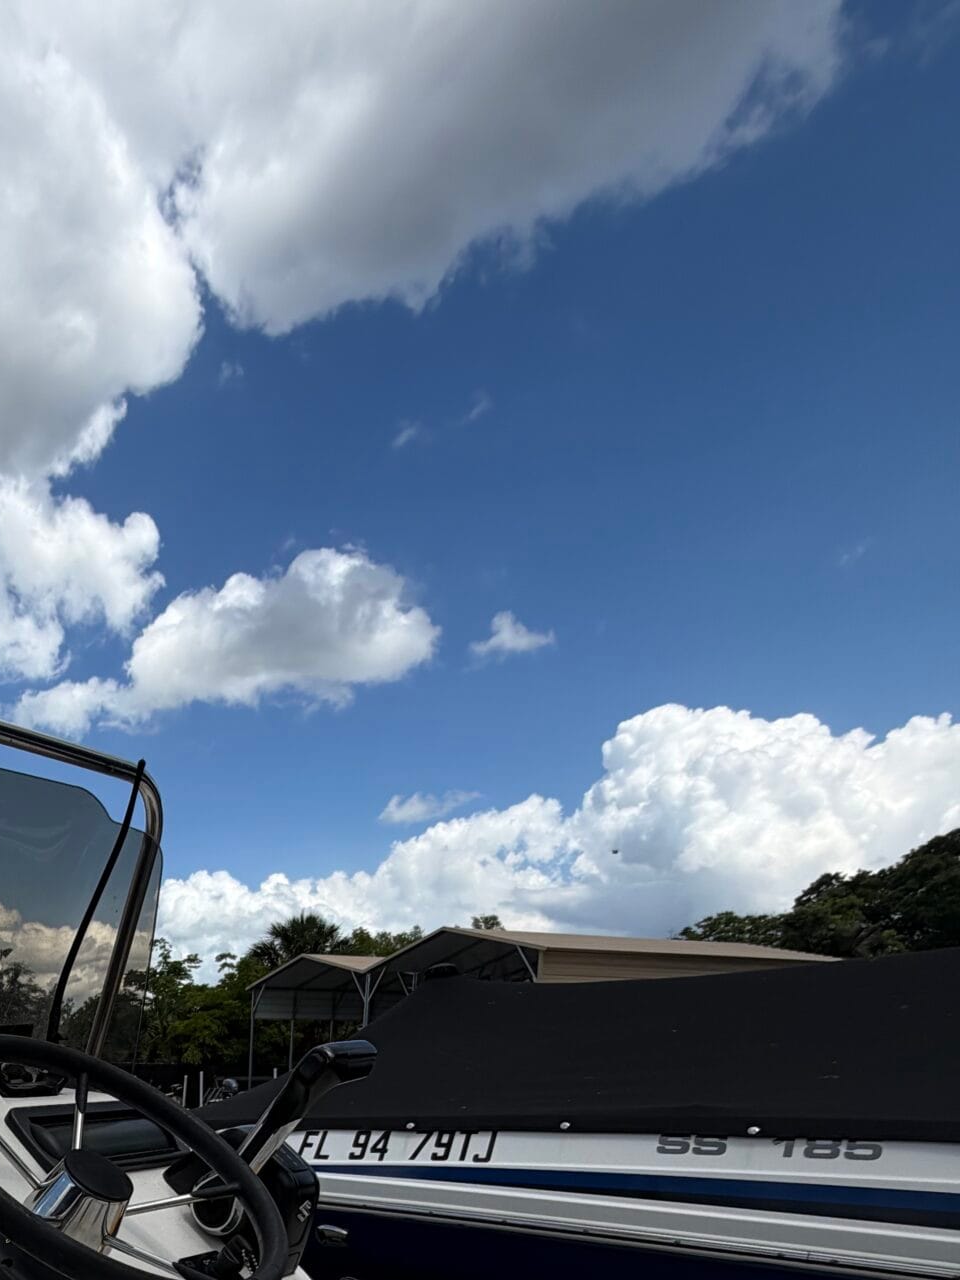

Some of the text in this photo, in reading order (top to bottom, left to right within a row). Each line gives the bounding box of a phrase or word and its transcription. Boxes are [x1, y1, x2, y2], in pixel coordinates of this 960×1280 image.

[299, 1130, 499, 1163] FL 94 79TJ
[771, 1138, 883, 1161] 185
